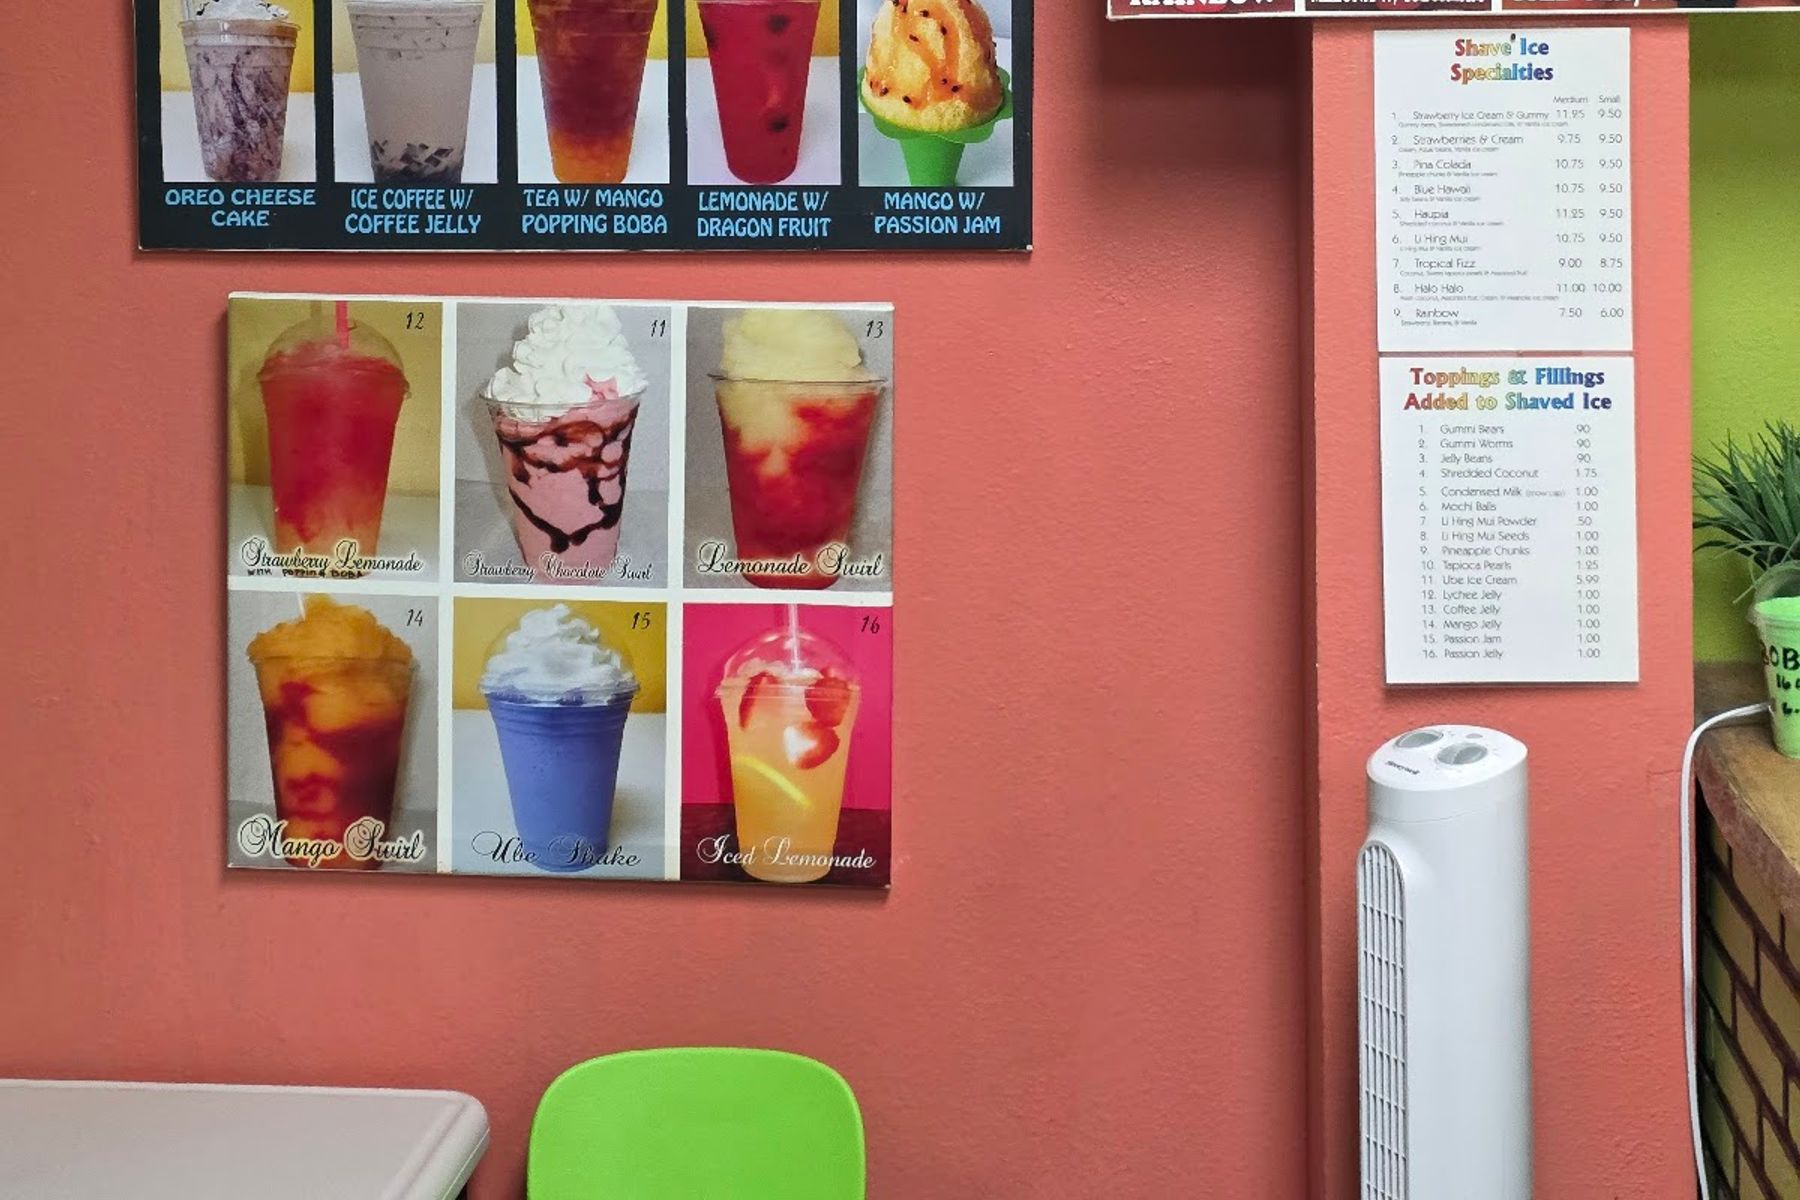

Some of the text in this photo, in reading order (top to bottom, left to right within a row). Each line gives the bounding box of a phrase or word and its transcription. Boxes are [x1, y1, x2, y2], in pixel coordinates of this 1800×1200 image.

[1519, 37, 1550, 56] Ice
[1450, 62, 1555, 85] Specialties
[165, 188, 317, 206] OREO CHEESE
[350, 188, 474, 210] ICE COFFEE W/
[523, 188, 664, 208] TEA W/ MANGO
[698, 190, 829, 212] LEMONADE W/
[883, 191, 986, 211] MANGO W/
[211, 209, 270, 227] CAKE
[344, 213, 482, 235] COFFEE JELLY
[521, 214, 668, 235] POPPING BOBA
[697, 216, 832, 238] DRAGON FRUIT
[874, 215, 1001, 236] PASSION JAM
[1558, 257, 1582, 268] 9.00
[1599, 258, 1623, 269] 8.75
[405, 311, 425, 330] 12
[649, 319, 667, 337] 11
[865, 319, 884, 339] 13
[1410, 367, 1606, 388] Toppings & Fillings
[1404, 391, 1612, 411] Added to Shaved Ice
[241, 537, 424, 573] Strawberry Lemonade
[697, 540, 886, 576] Lemonade Swirl
[406, 608, 423, 627] 14
[631, 611, 650, 630] 15
[860, 615, 880, 634] 16
[239, 816, 424, 866] Mango Swirl
[696, 833, 877, 869] Iced Lemonade
